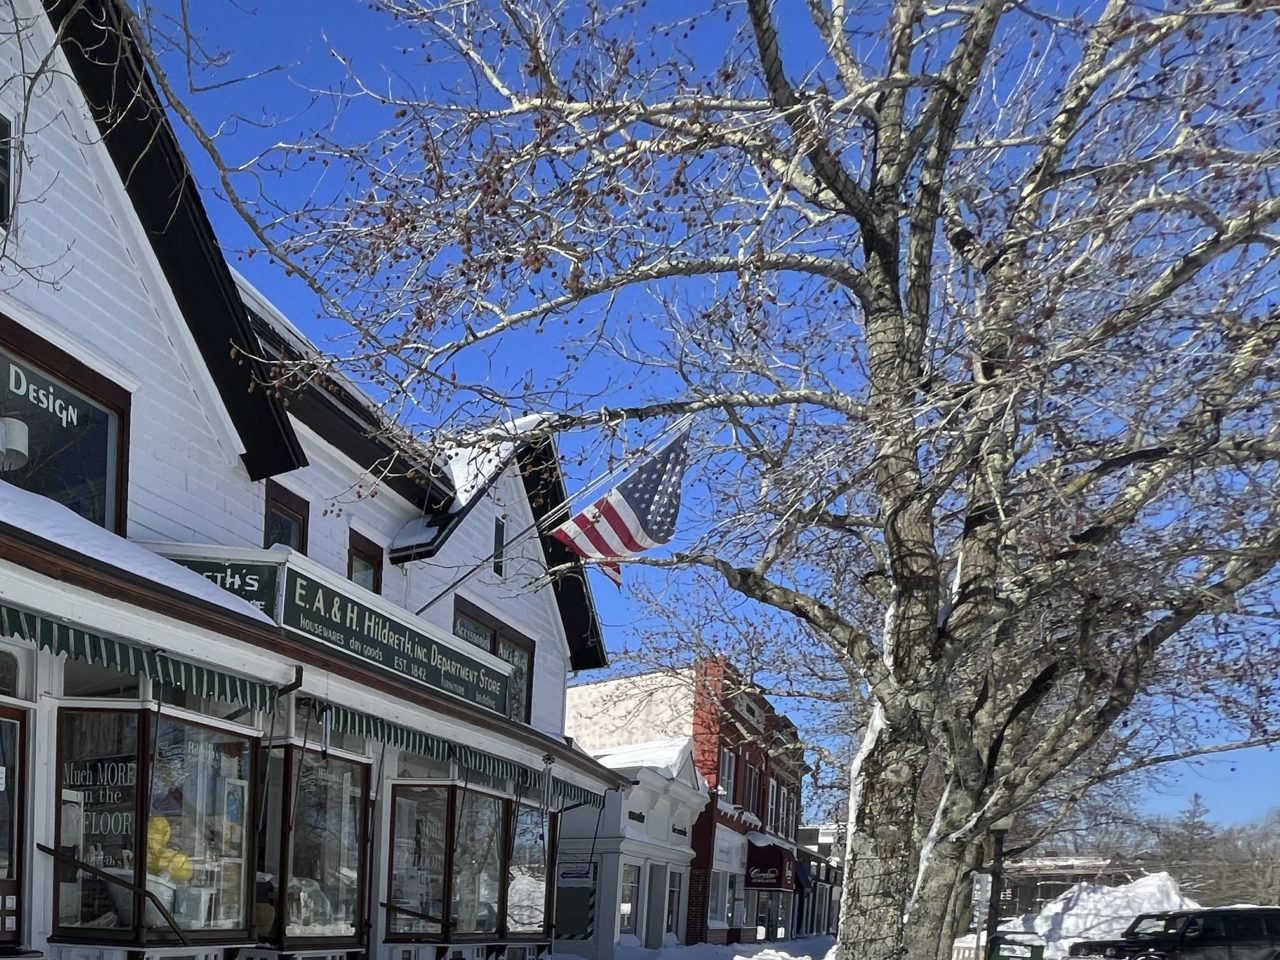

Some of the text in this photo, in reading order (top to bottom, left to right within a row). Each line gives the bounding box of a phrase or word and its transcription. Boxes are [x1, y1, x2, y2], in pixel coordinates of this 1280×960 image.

[411, 663, 426, 680] 1842
[63, 762, 137, 786] Much MORE
[99, 785, 122, 803] the
[82, 811, 132, 835] FLOOR
